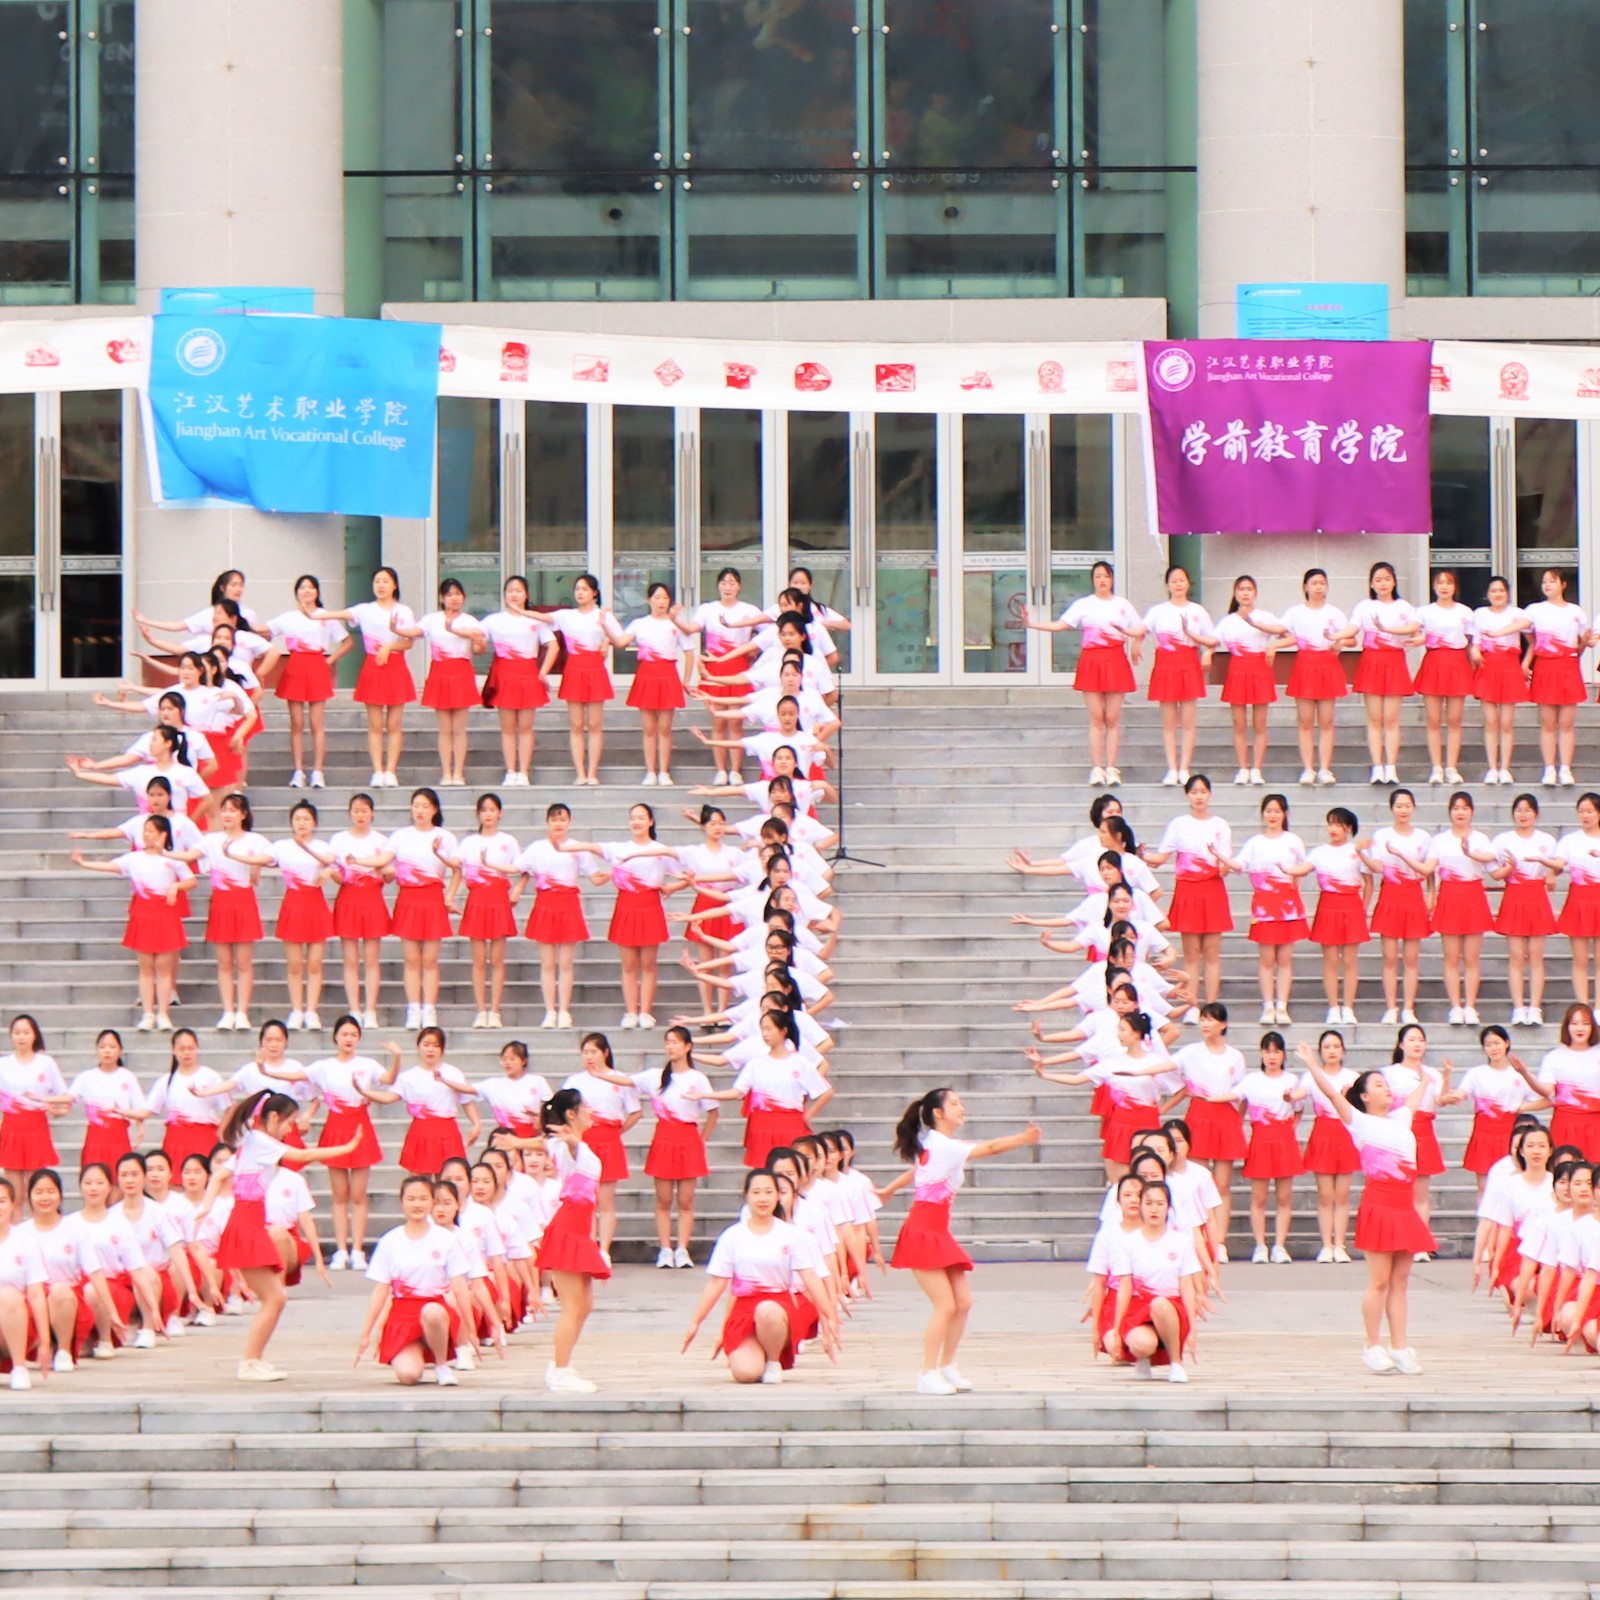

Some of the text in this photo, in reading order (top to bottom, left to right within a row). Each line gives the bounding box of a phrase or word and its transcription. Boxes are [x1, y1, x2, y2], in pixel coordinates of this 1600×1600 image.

[1206, 354, 1334, 370] 江汉艺术职业学院
[174, 391, 409, 427] 江汉艺术职业学院
[175, 420, 407, 451] Jianghan Art Vocational College
[1180, 418, 1408, 466] 学前教育学院
